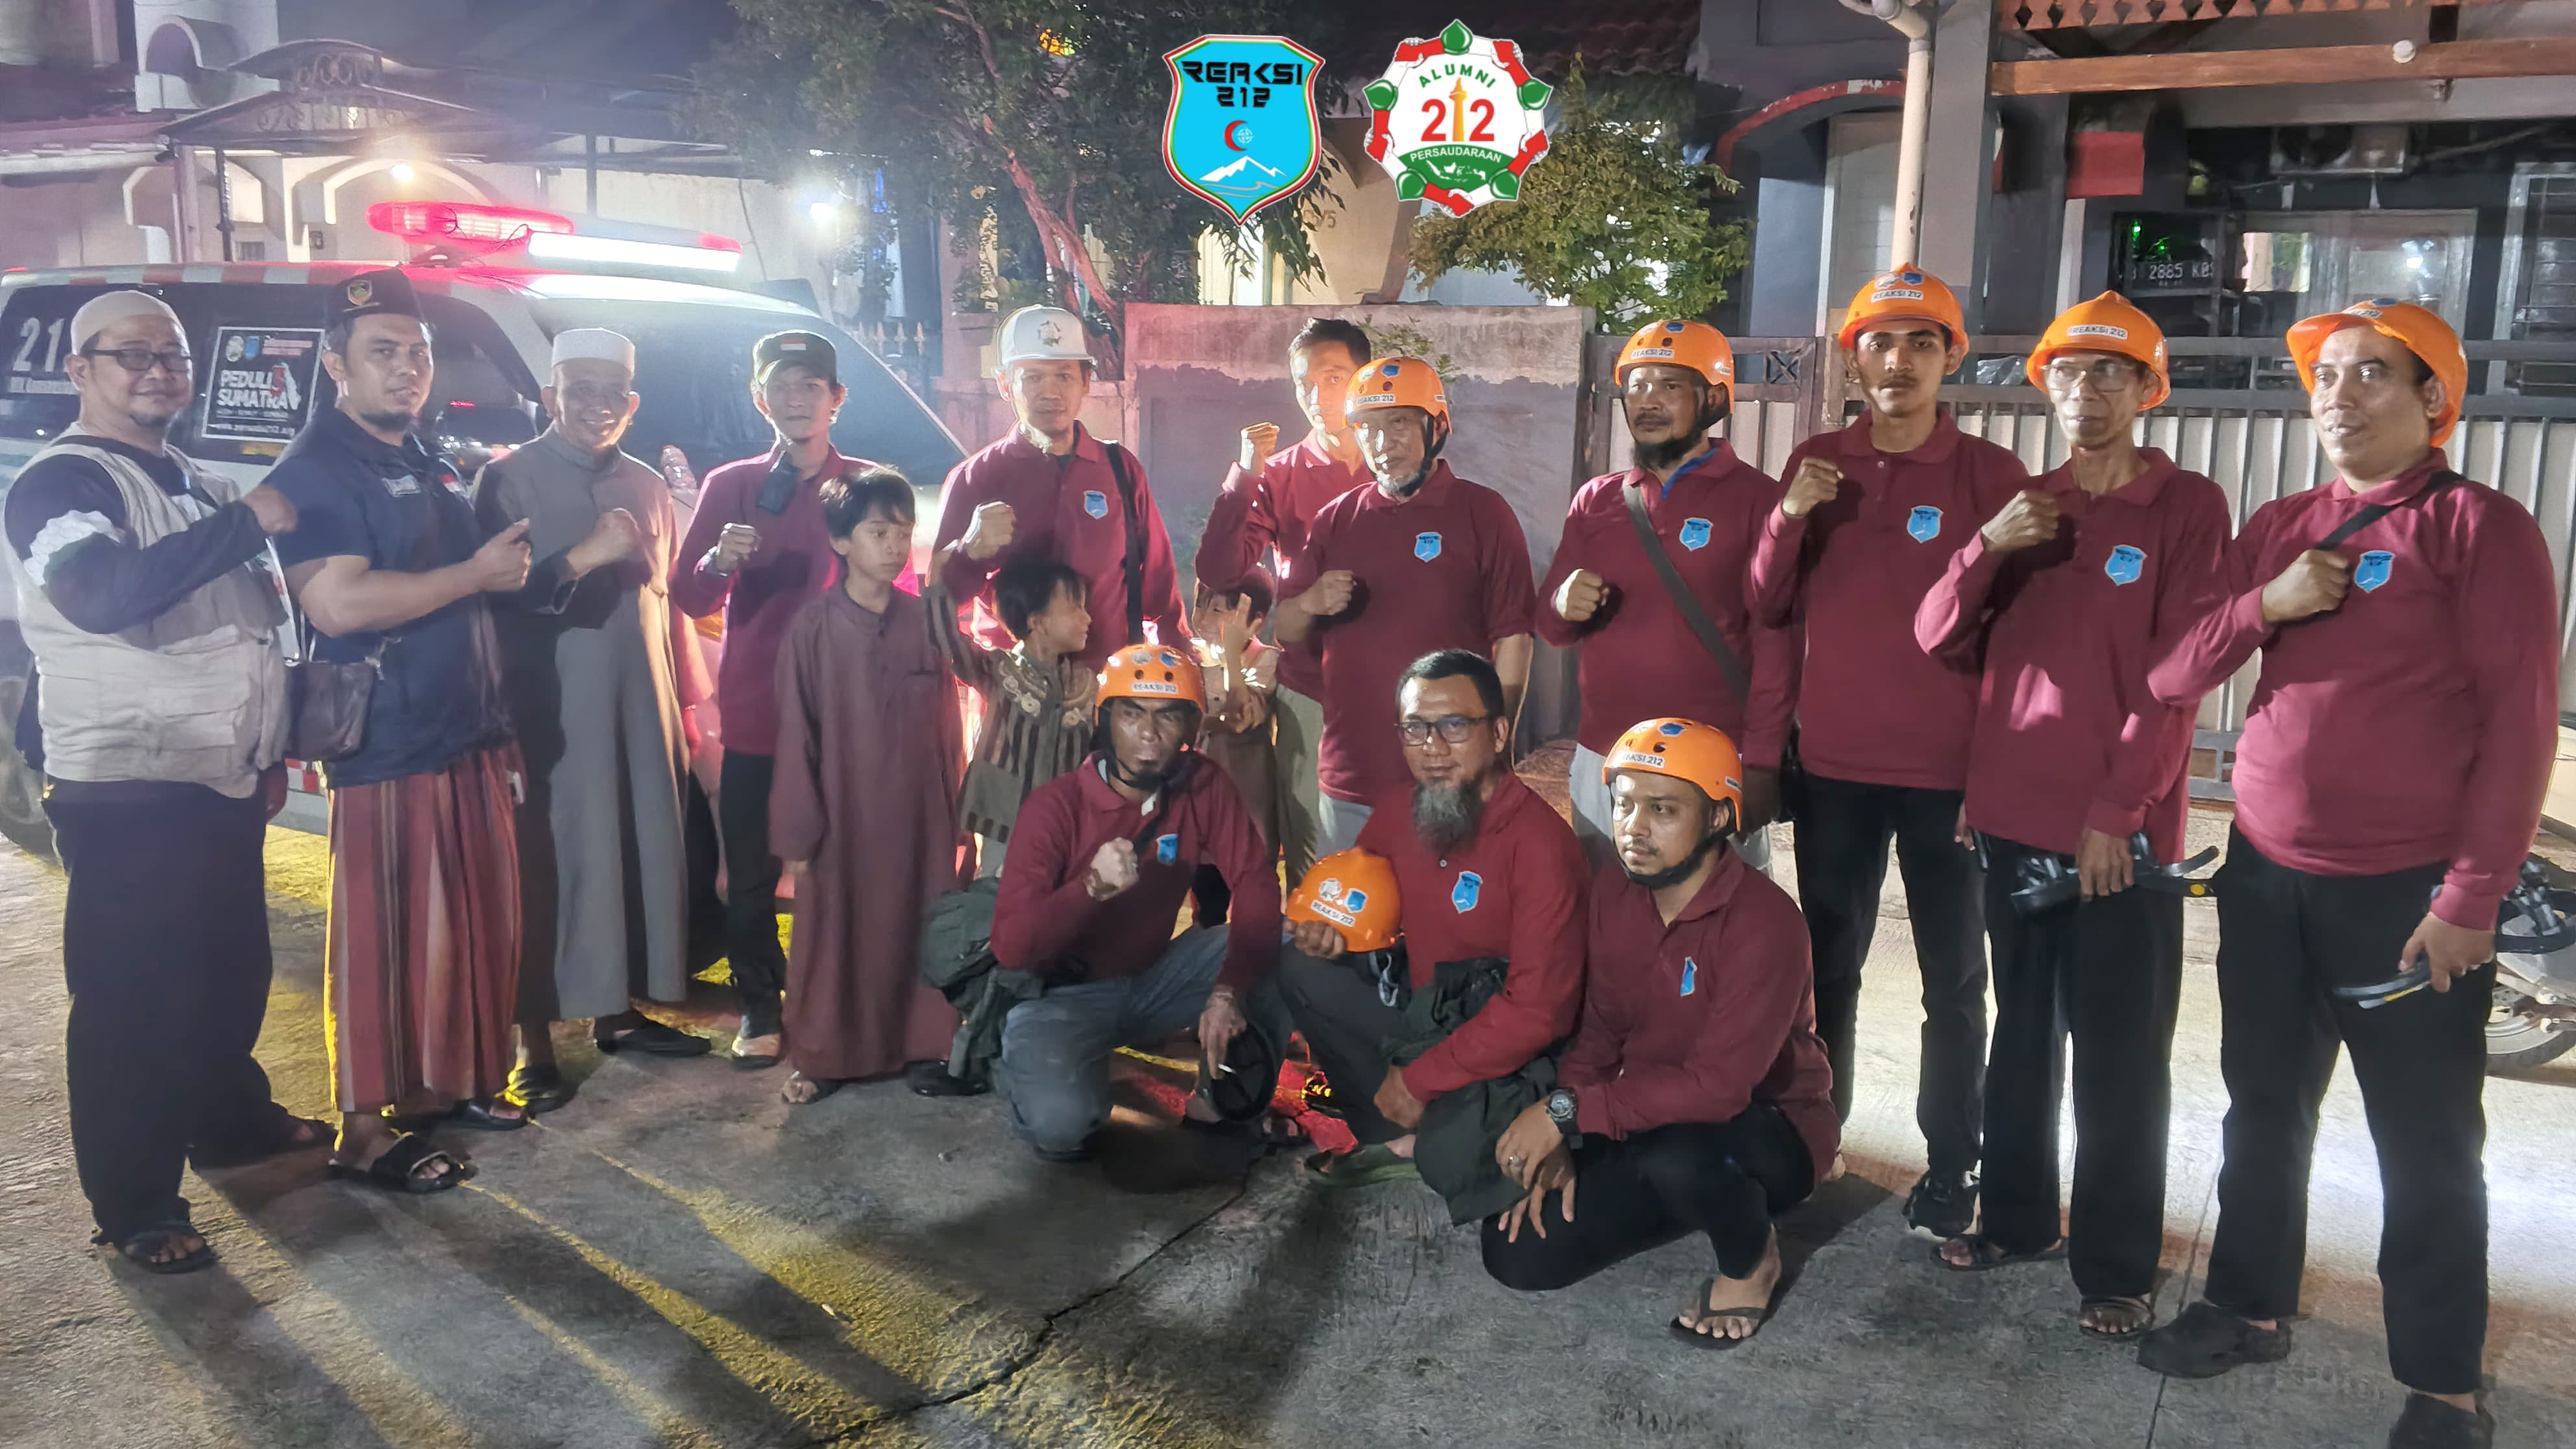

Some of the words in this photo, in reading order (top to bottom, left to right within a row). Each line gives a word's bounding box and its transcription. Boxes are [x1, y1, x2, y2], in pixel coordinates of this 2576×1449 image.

[2149, 263, 2183, 280] 2885
[2109, 328, 2126, 337] 212
[12, 317, 68, 373] 21
[220, 369, 273, 389] PEDULI
[1622, 754, 1646, 762] AKSI
[1647, 756, 1664, 766] 212
[1340, 915, 1354, 925] 212
